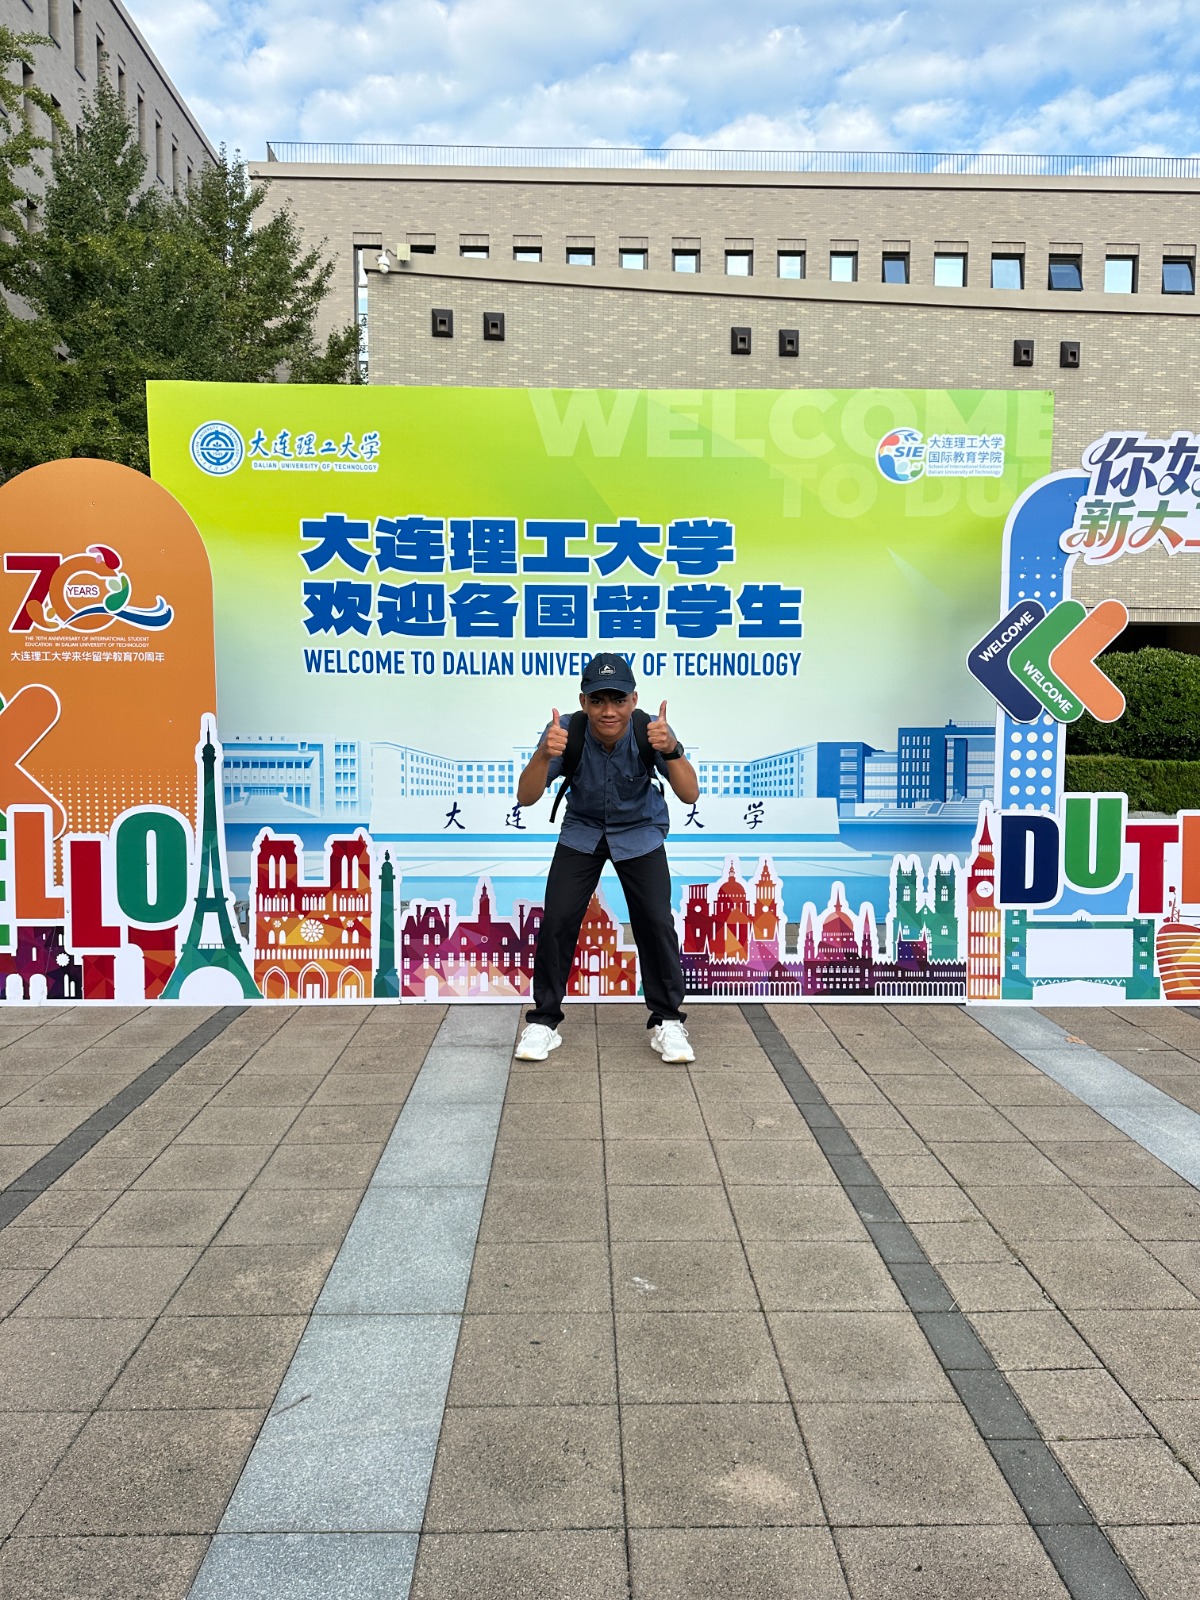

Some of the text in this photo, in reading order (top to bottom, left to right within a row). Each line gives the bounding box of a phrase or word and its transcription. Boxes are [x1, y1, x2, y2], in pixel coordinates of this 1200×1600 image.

[527, 387, 1053, 458] WELCOME
[252, 430, 379, 460] 大连理工大学
[893, 446, 925, 458] SIE
[928, 451, 1002, 463] 国际教育学院
[929, 437, 1003, 449] 大连理工大学
[335, 463, 377, 471] TECHNOLOGY
[769, 463, 878, 518] TO
[301, 515, 733, 576] 大连理工大学
[67, 587, 98, 595] YEARS
[302, 581, 802, 638] 欢迎各国留学生
[979, 611, 1034, 662] WELCOME
[11, 651, 165, 663] 大连理工大学来华留学教育70周年
[303, 650, 802, 676] WELCOME TO DALIAN UNIVERY OF TECHNOLOGY
[1023, 660, 1073, 714] WELCOME
[0, 811, 188, 948] LLO
